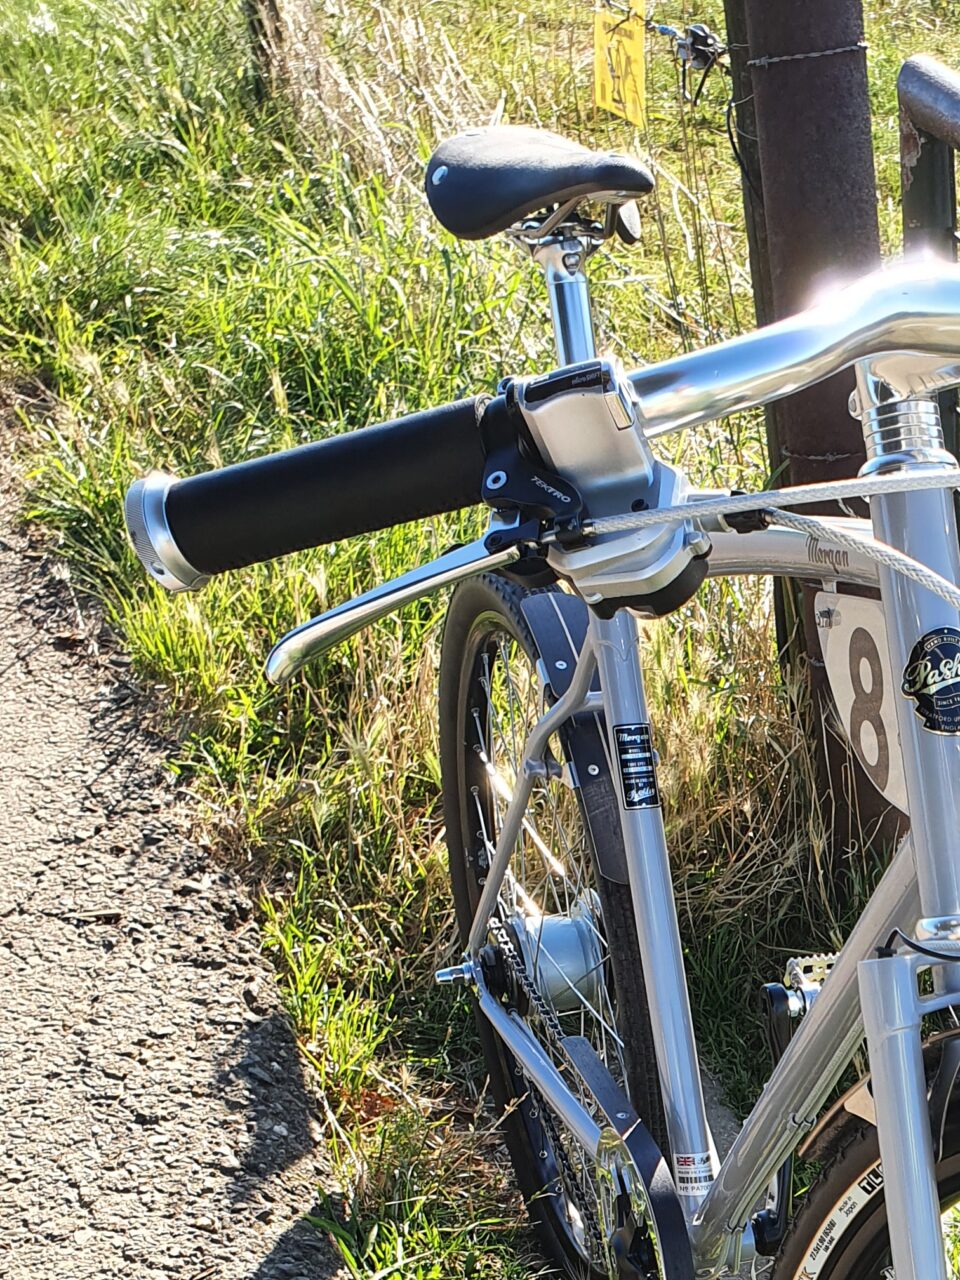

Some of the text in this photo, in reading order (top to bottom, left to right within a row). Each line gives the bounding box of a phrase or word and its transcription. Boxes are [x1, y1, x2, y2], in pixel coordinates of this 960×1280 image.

[530, 474, 572, 504] TEKTRO
[805, 533, 849, 575] Morgan
[848, 626, 889, 793] 8
[844, 1201, 858, 1218] Japan
